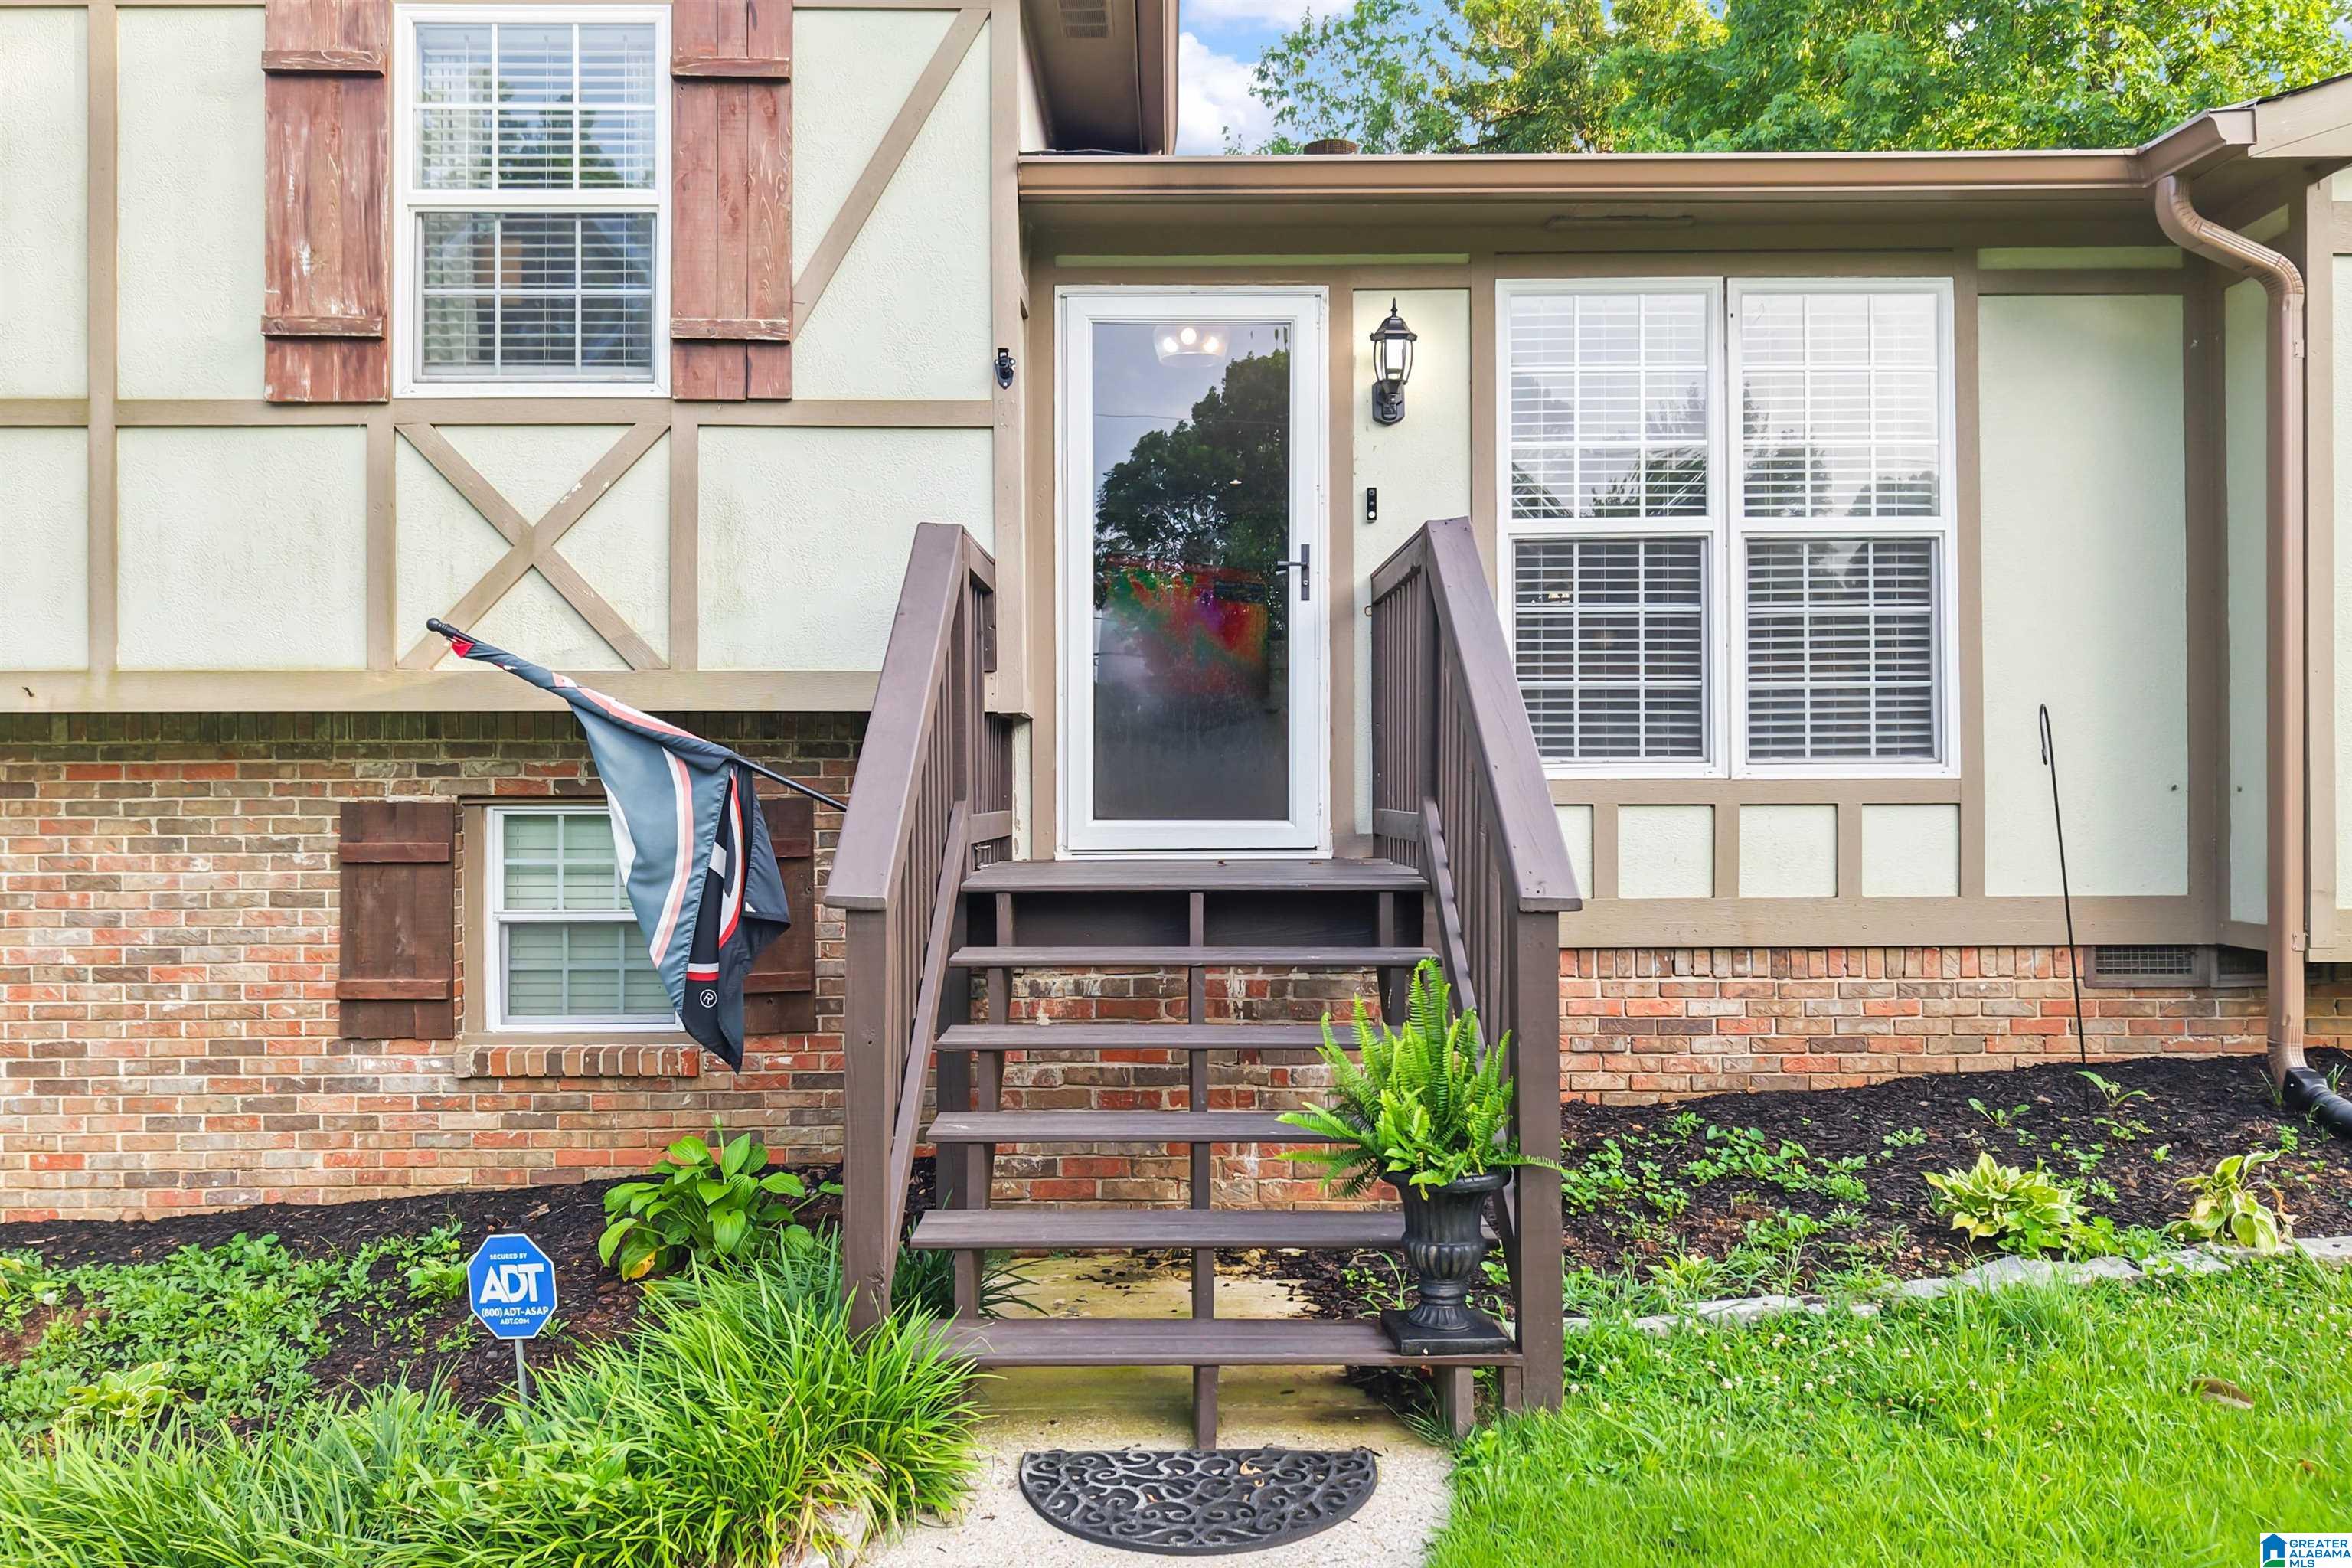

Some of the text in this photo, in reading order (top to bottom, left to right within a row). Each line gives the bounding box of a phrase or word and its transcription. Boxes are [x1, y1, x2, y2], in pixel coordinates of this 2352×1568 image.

[479, 1263, 544, 1304] ADT
[482, 1306, 549, 1318] (800) ADT-ASAP
